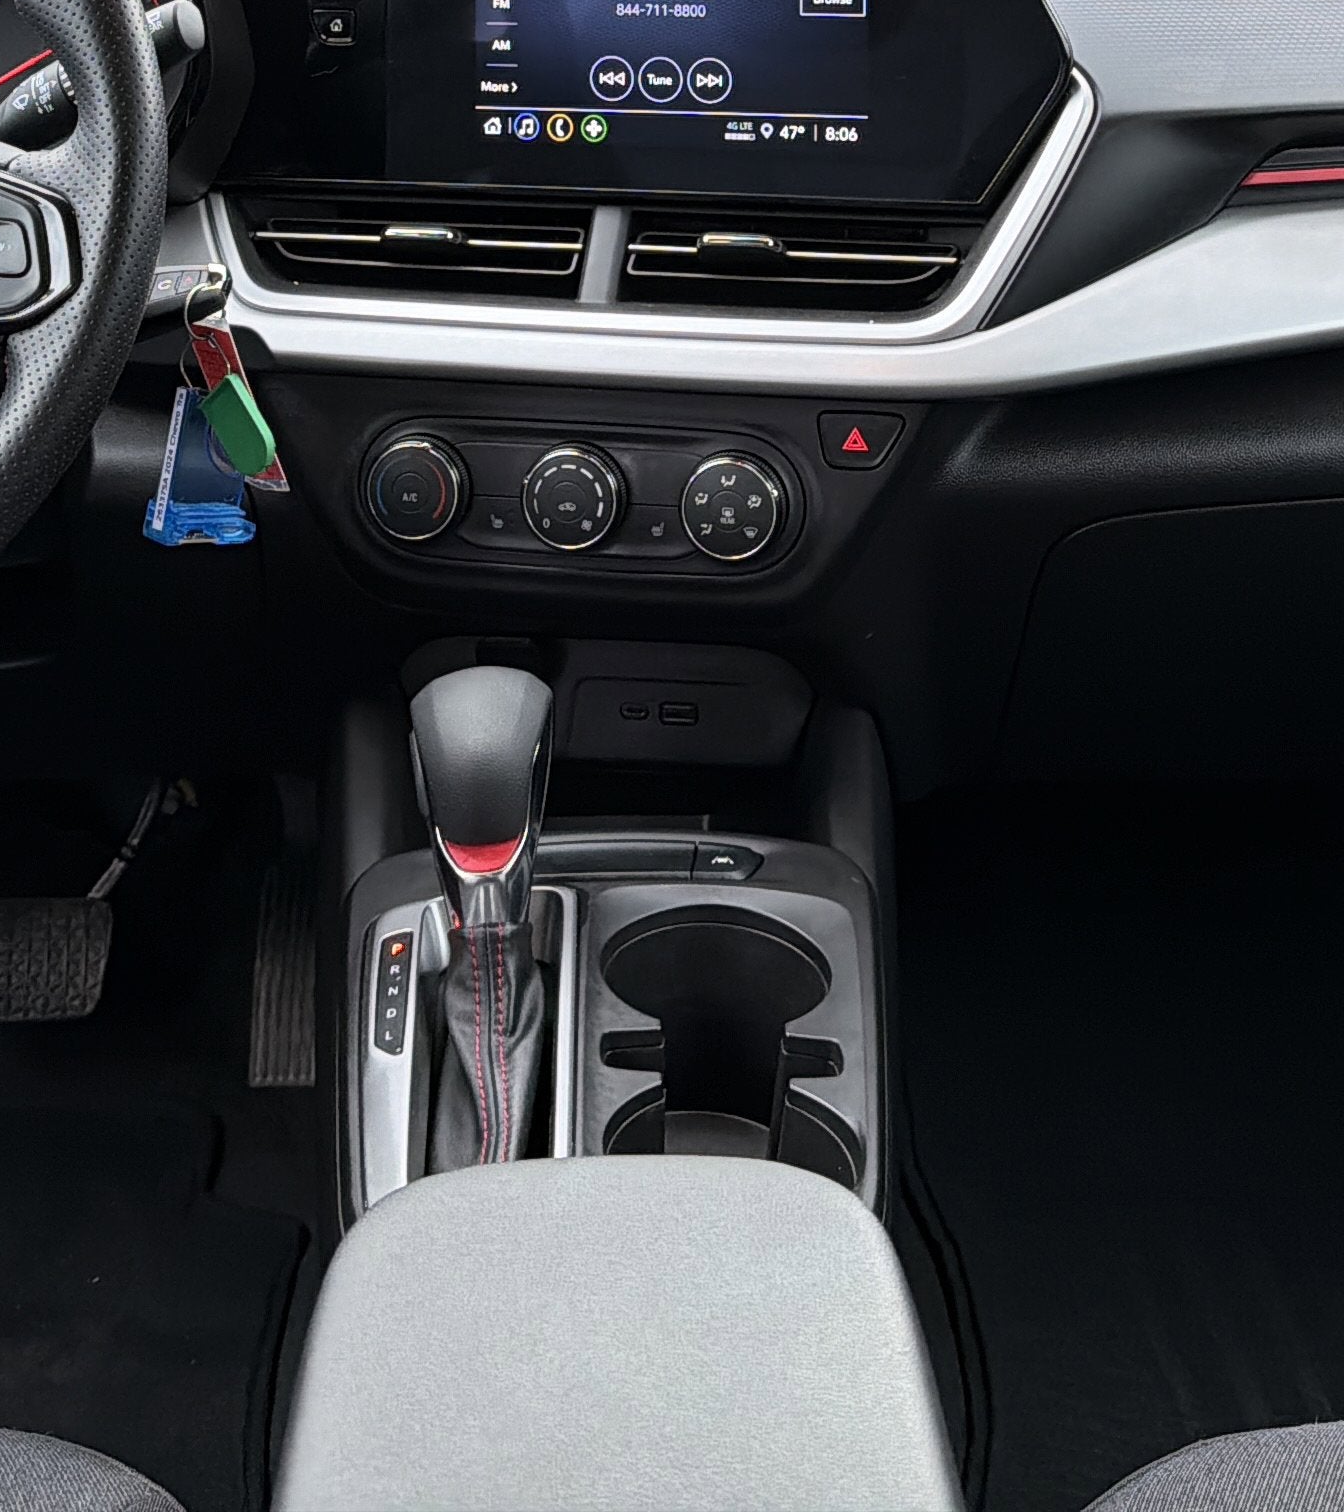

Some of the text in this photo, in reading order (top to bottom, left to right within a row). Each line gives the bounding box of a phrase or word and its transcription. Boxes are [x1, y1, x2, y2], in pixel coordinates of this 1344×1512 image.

[615, 3, 707, 18] 844-711-8800
[492, 39, 511, 51] AM
[646, 73, 674, 87] Tune
[481, 81, 509, 93] More
[726, 121, 754, 131] 4G LTE
[824, 126, 859, 142] 8:06
[163, 448, 174, 475] 2024
[401, 491, 418, 503] A/C
[391, 942, 405, 956] P
[389, 964, 401, 976] R
[387, 985, 399, 997] N
[386, 1008, 397, 1019] D
[384, 1030, 394, 1041] L
